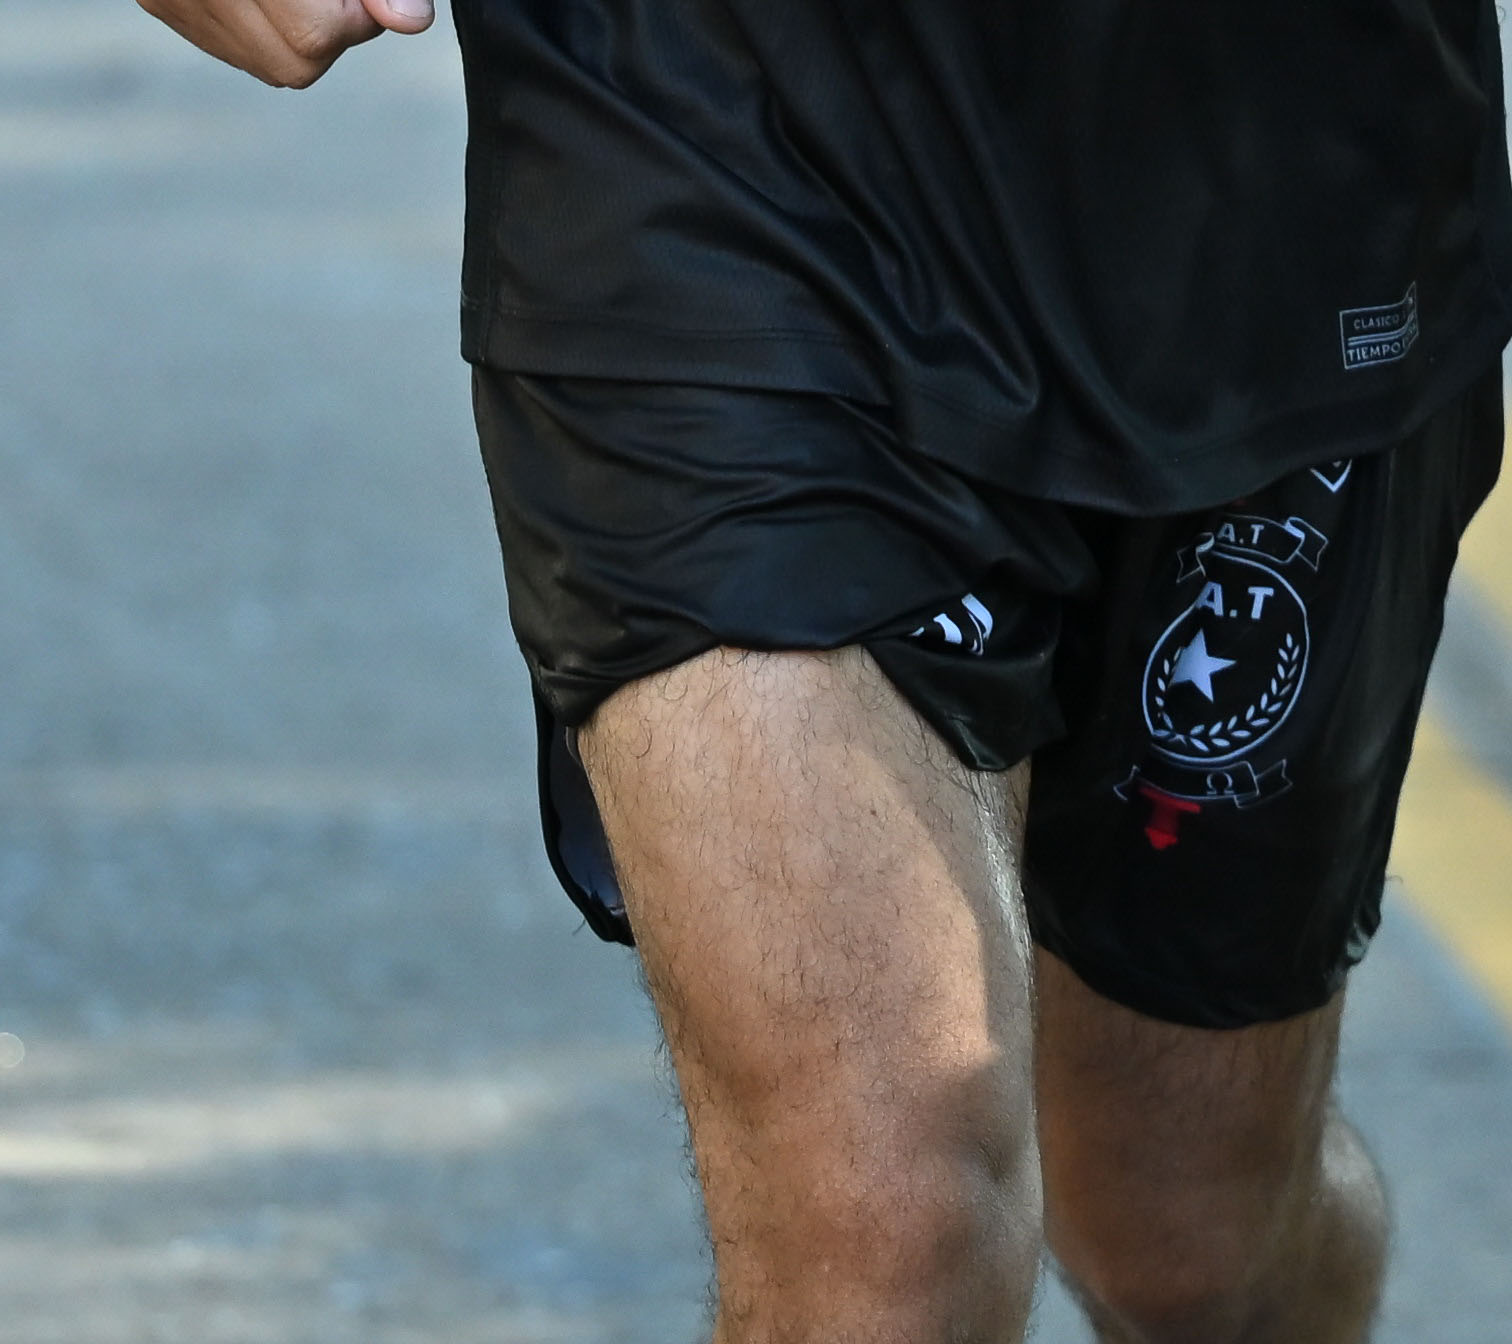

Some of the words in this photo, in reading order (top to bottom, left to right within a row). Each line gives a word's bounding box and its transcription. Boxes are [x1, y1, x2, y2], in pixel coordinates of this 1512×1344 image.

[1353, 313, 1400, 330] CLASICO
[1347, 342, 1402, 363] TIEMPO
[1217, 522, 1265, 545] A.T
[1193, 580, 1275, 620] A.T
